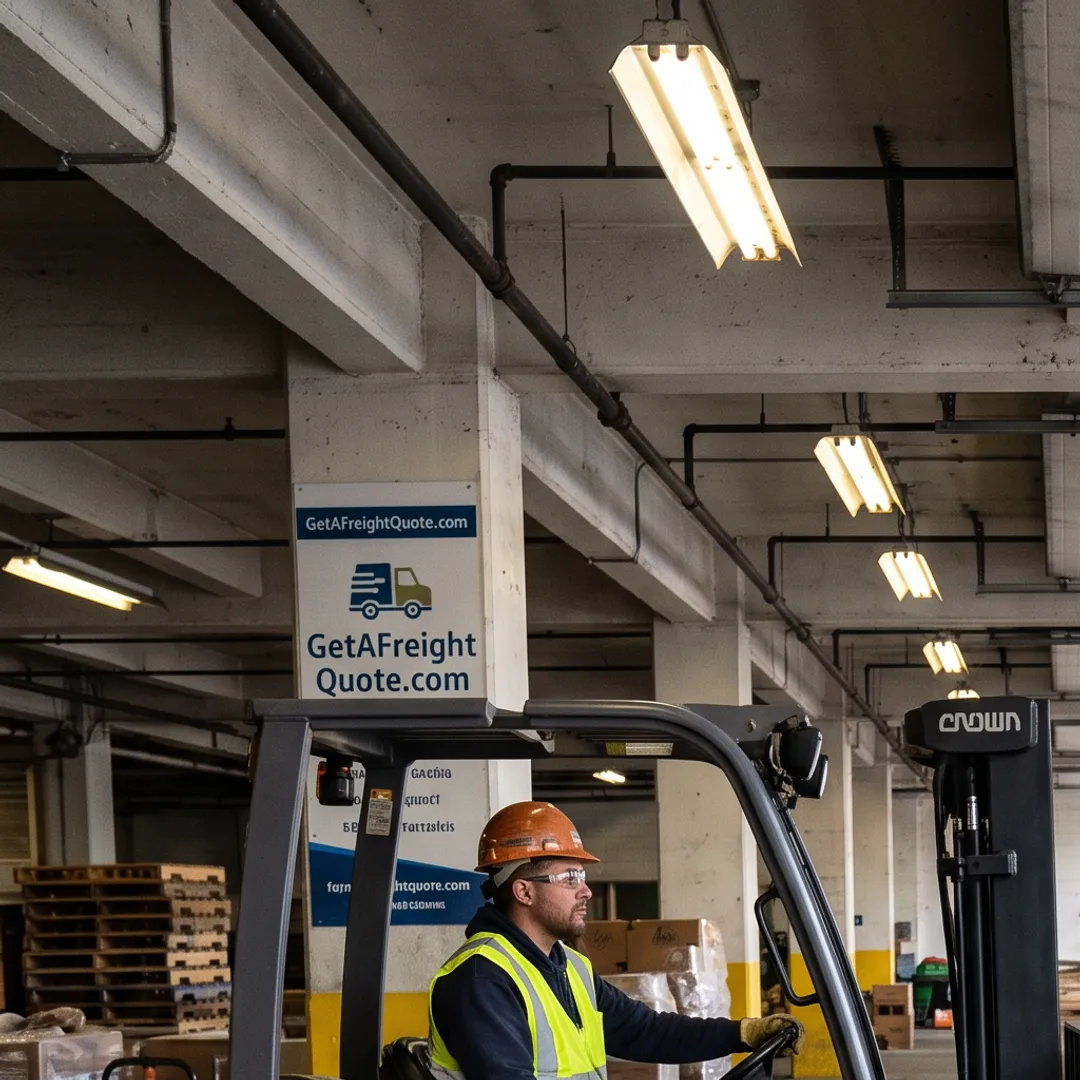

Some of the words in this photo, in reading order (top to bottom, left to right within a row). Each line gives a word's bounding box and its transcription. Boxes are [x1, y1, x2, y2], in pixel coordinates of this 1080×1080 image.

[305, 515, 469, 534] GetAFreightQuote.com
[307, 631, 477, 665] GetAFreight
[316, 667, 470, 697] Quote.com
